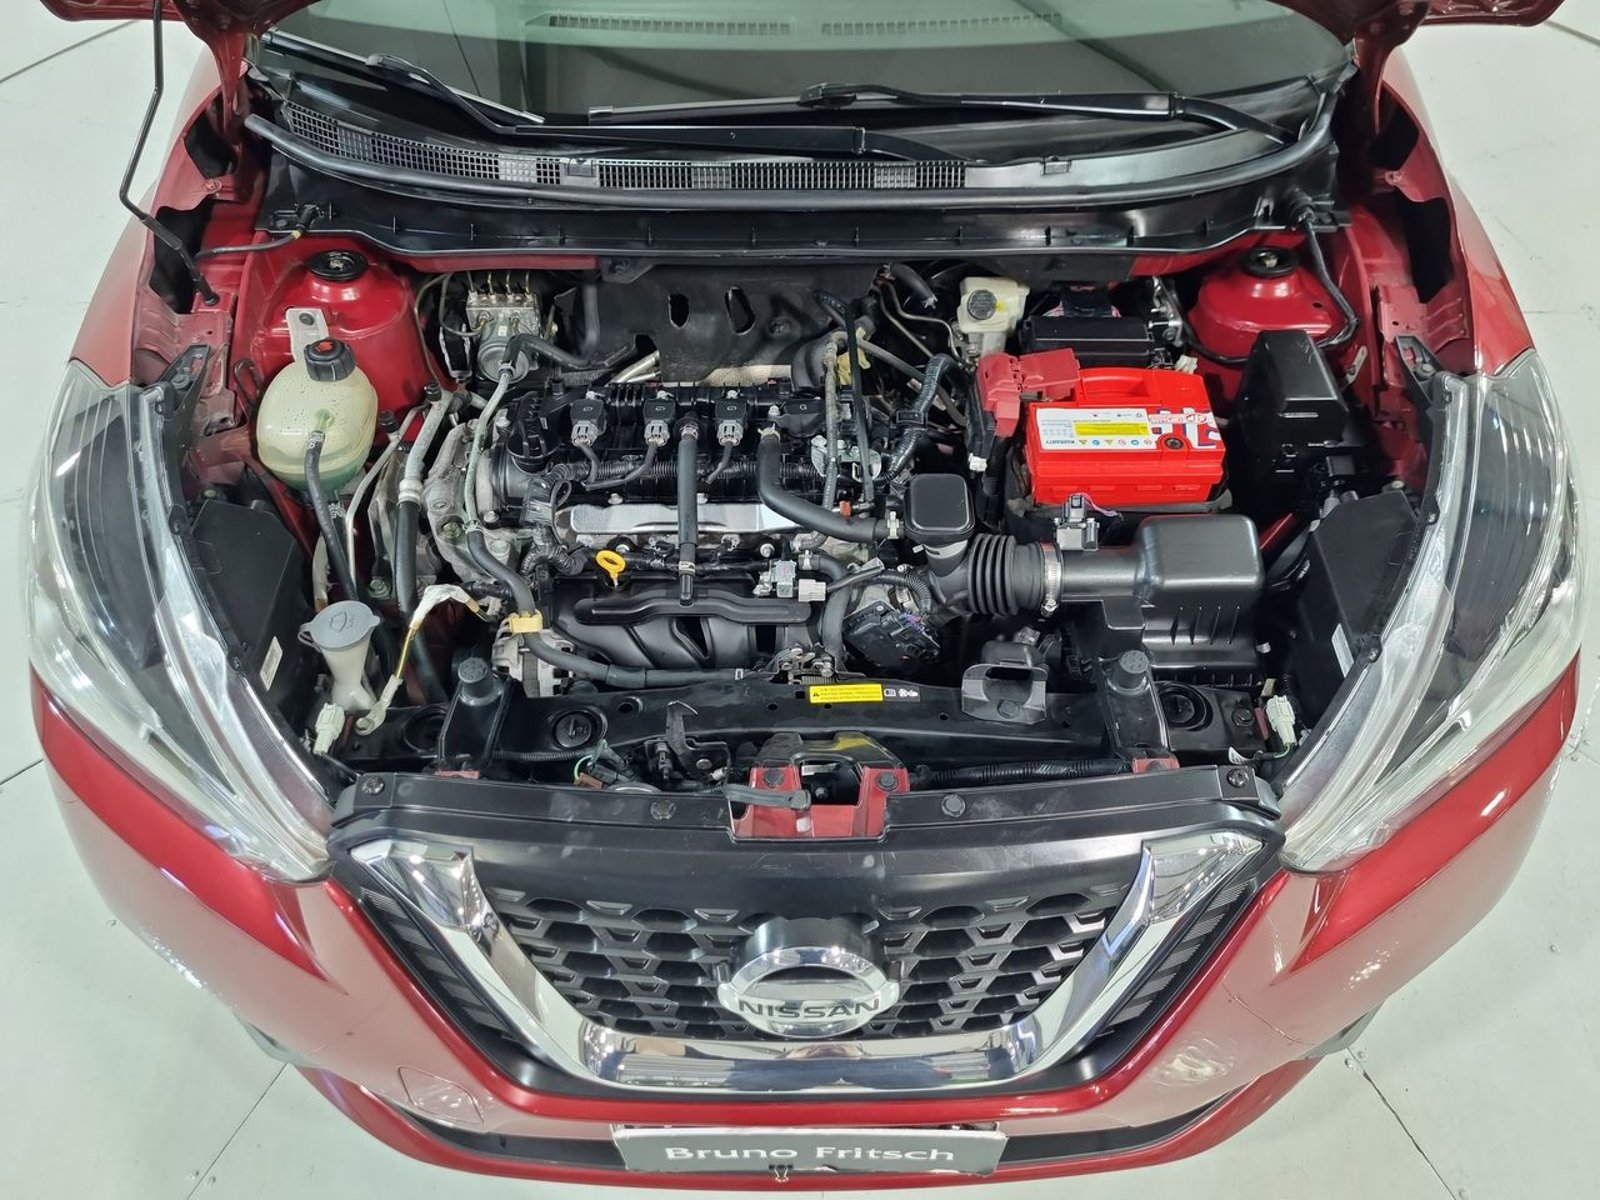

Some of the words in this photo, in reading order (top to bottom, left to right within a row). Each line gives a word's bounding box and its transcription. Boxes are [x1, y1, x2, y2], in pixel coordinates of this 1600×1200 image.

[739, 998, 879, 1019] NISSAN
[665, 1147, 798, 1160] Bruno
[816, 1146, 954, 1161] Fritsch
